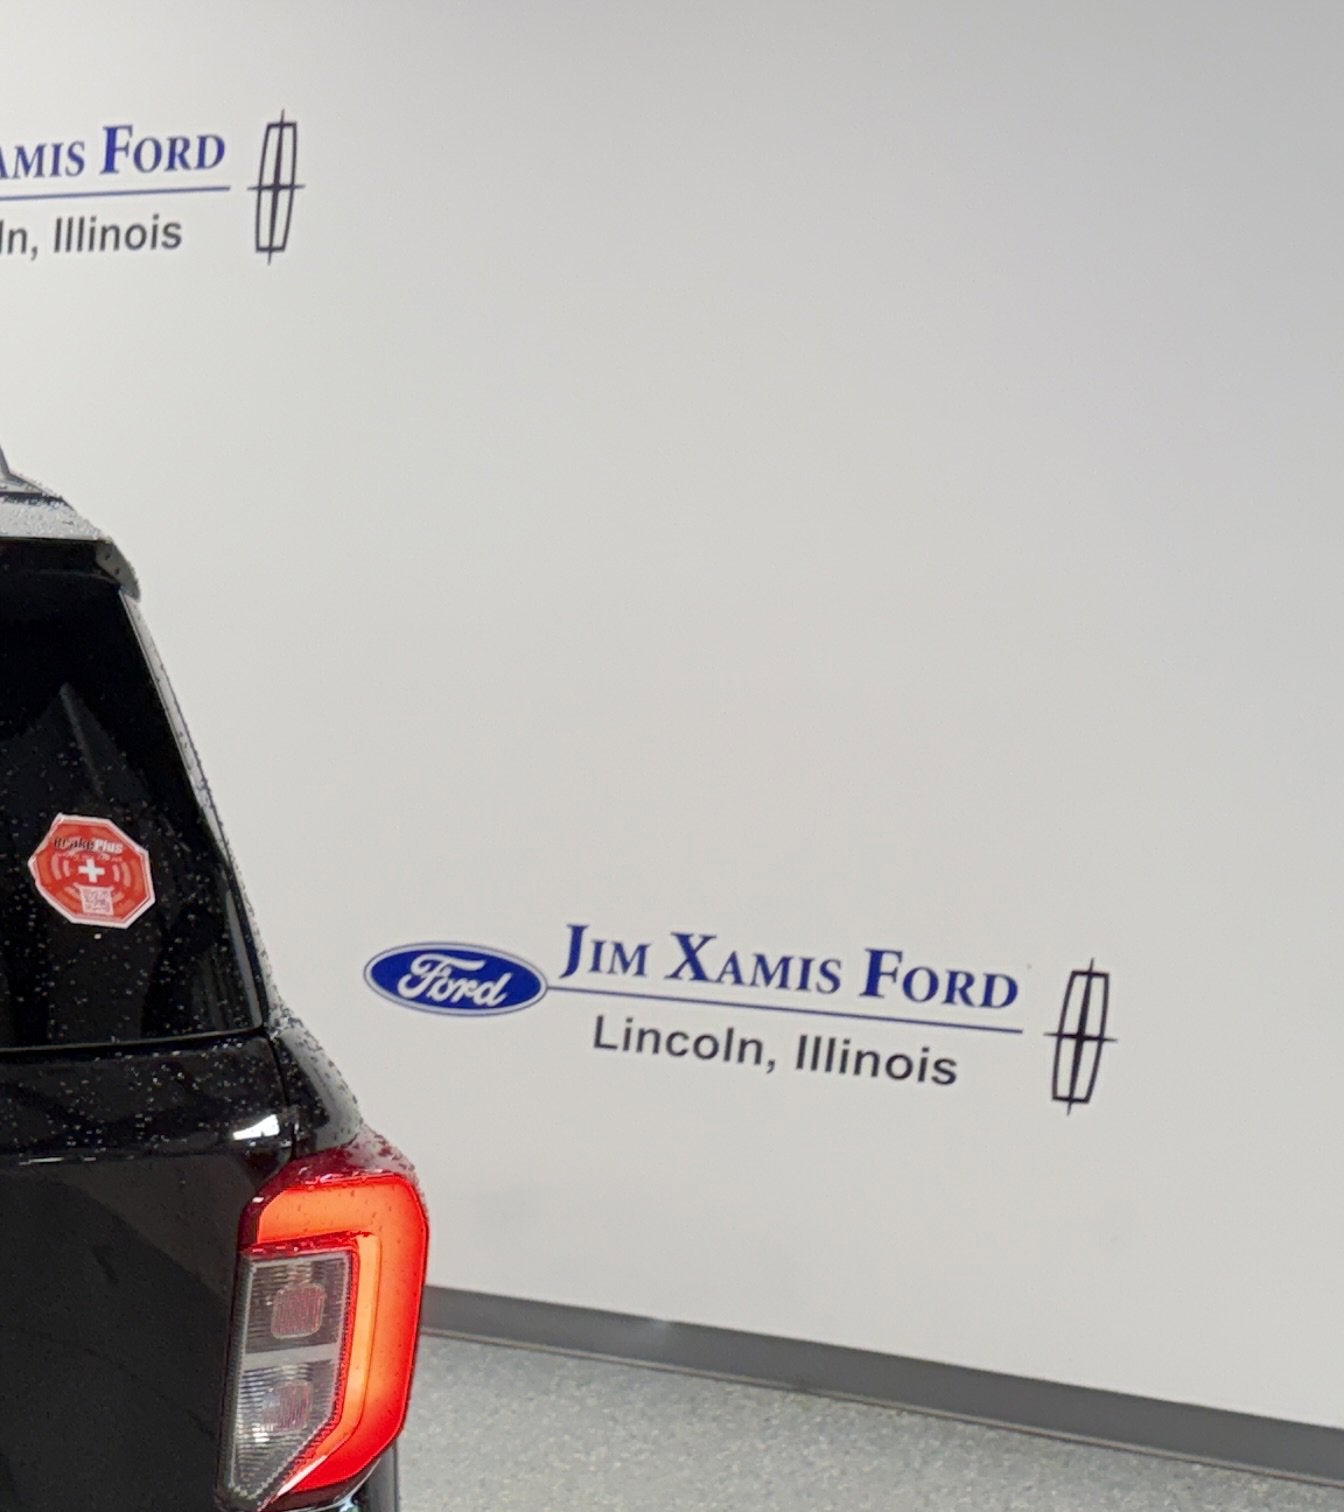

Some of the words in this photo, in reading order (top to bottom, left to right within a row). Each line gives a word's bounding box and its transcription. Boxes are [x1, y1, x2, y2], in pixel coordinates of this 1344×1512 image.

[100, 125, 225, 174] FORD
[53, 214, 182, 254] Illinois
[397, 954, 510, 1009] Ford
[560, 924, 652, 979] JIM
[663, 932, 842, 995] XAMIS
[859, 948, 1020, 1009] FORD
[593, 1015, 776, 1073] Lincoln,
[795, 1036, 960, 1085] Illinois
